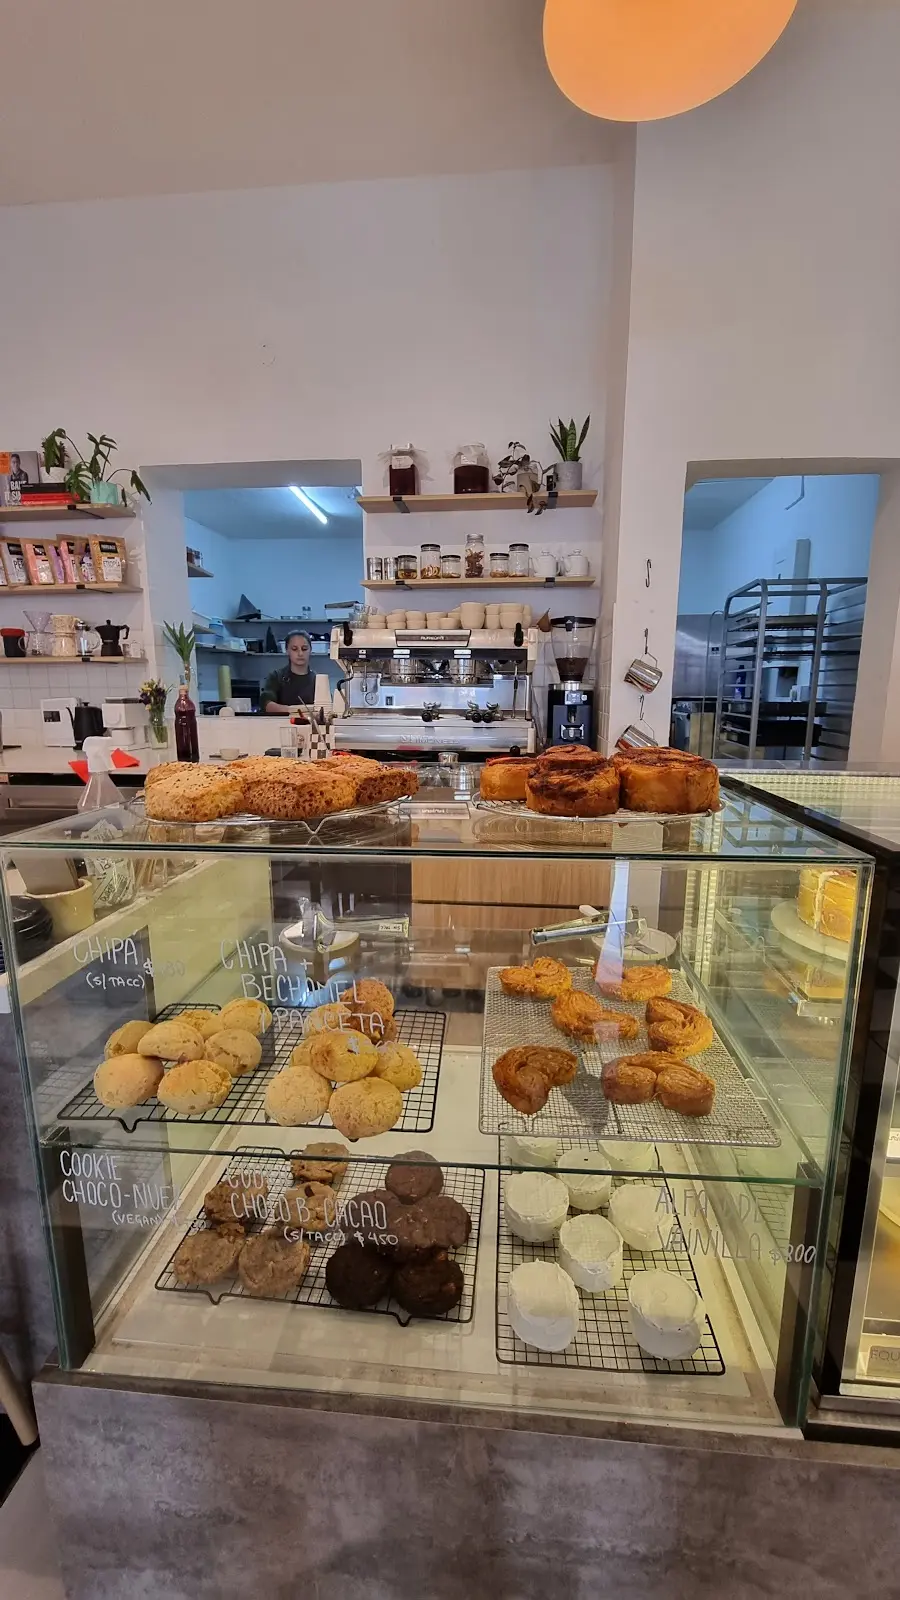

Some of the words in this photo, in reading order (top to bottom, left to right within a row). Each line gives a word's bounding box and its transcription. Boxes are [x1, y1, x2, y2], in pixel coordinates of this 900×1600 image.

[73, 936, 138, 965] CHIPA
[220, 939, 288, 972] CHIPA
[299, 958, 313, 970] +
[59, 1150, 122, 1181] COOKIE
[230, 1192, 292, 1223] CHOCO
[323, 1197, 388, 1230] CACAO
